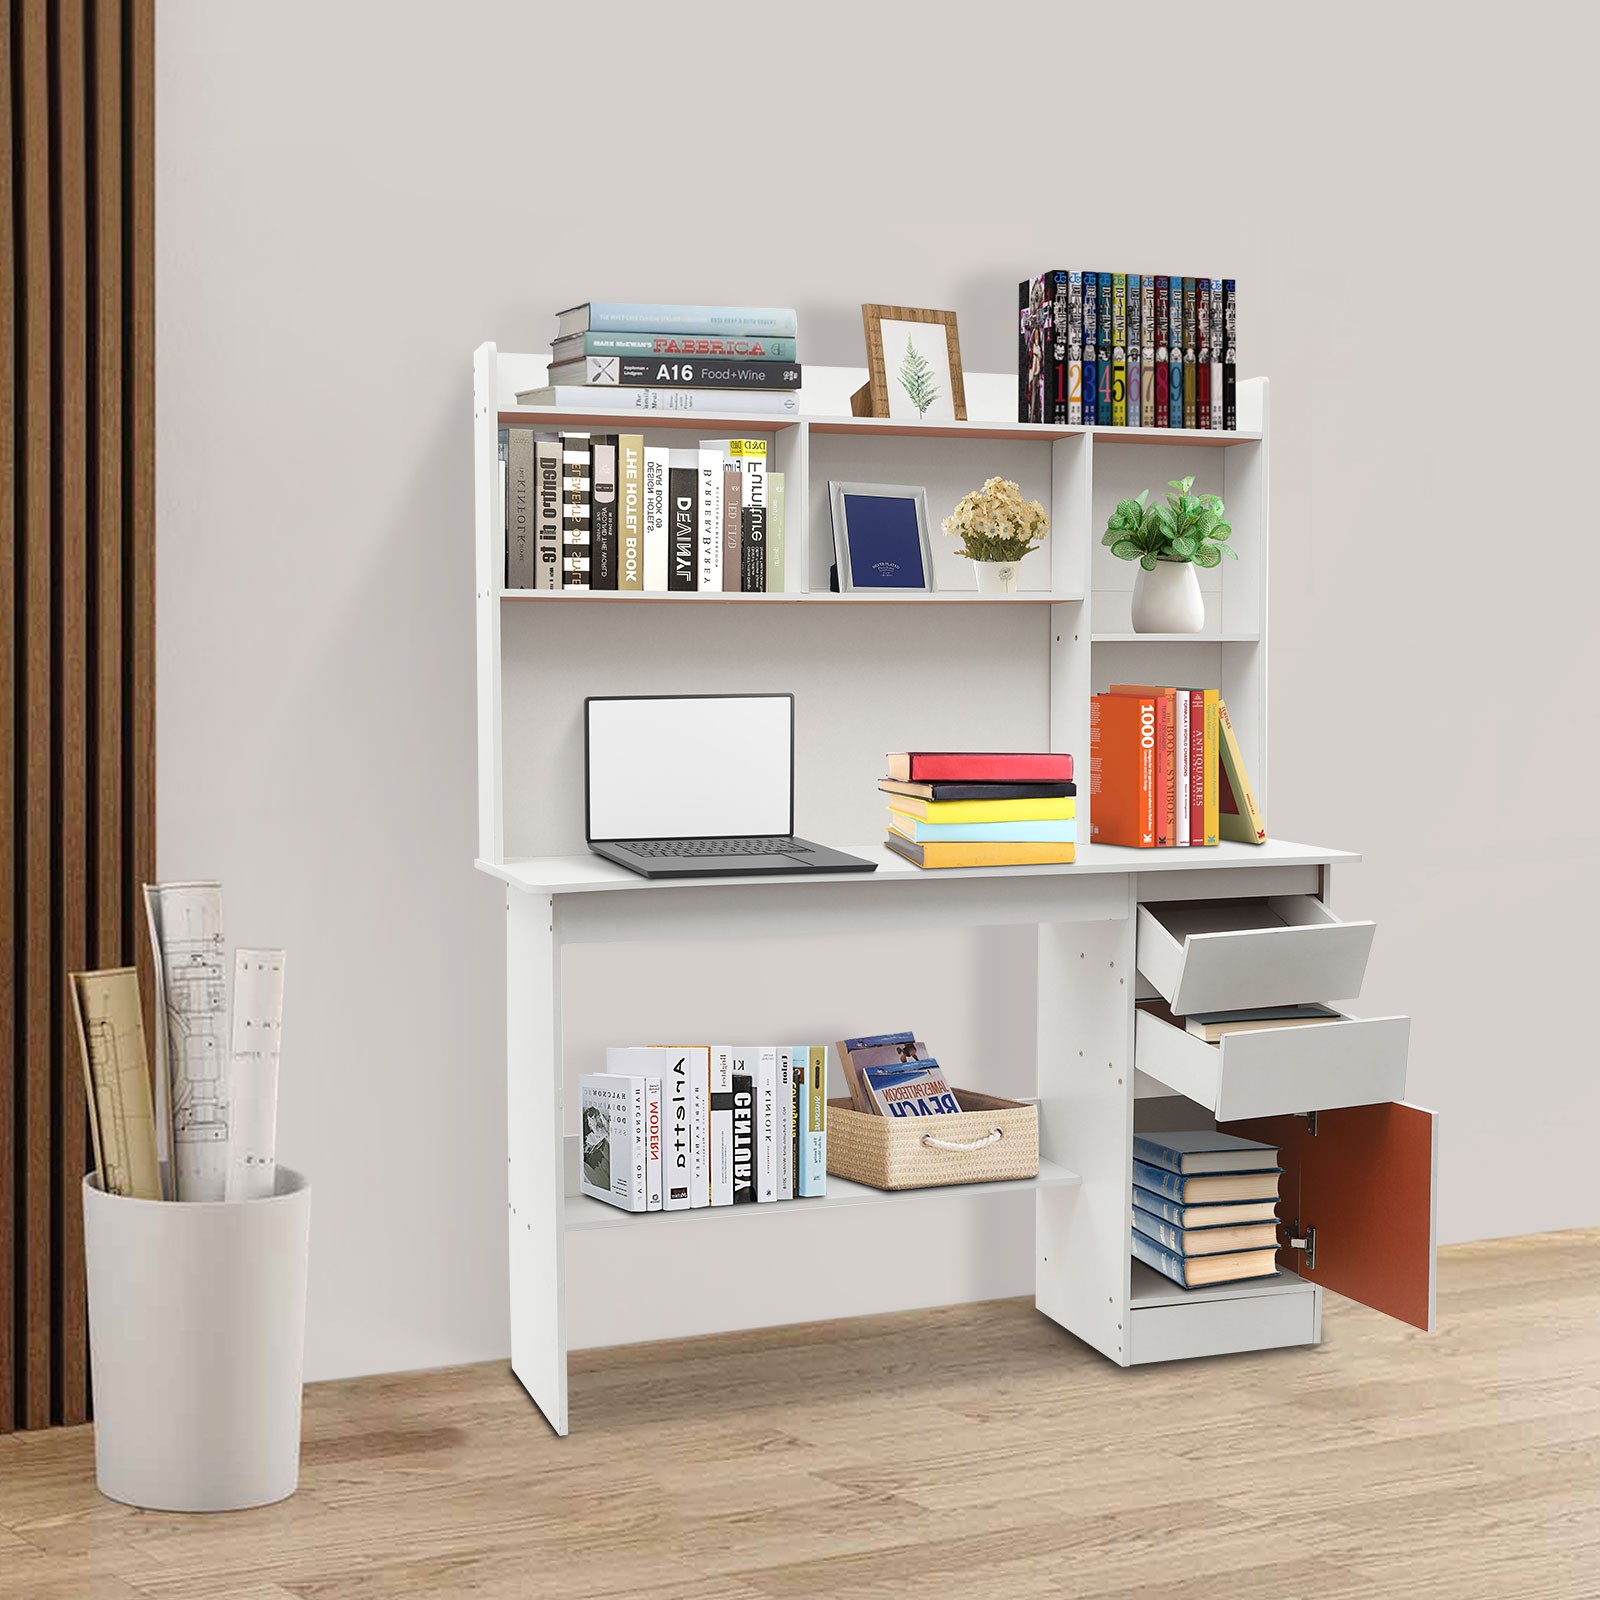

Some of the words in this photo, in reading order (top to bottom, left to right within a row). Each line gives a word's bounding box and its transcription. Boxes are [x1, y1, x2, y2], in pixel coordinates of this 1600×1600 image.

[653, 338, 766, 356] FABBRICA
[656, 365, 693, 381] A16
[1056, 365, 1065, 402] 1
[1069, 365, 1081, 402] 2
[1083, 365, 1095, 402] 3
[1099, 365, 1110, 402] 4
[1113, 366, 1125, 402] 5
[1128, 366, 1139, 402] 6
[1143, 367, 1154, 402] 7
[1157, 367, 1168, 402] 8
[1170, 366, 1182, 402] 9
[1141, 704, 1154, 748] 1000
[1195, 730, 1203, 806] ANTIQUAIRES
